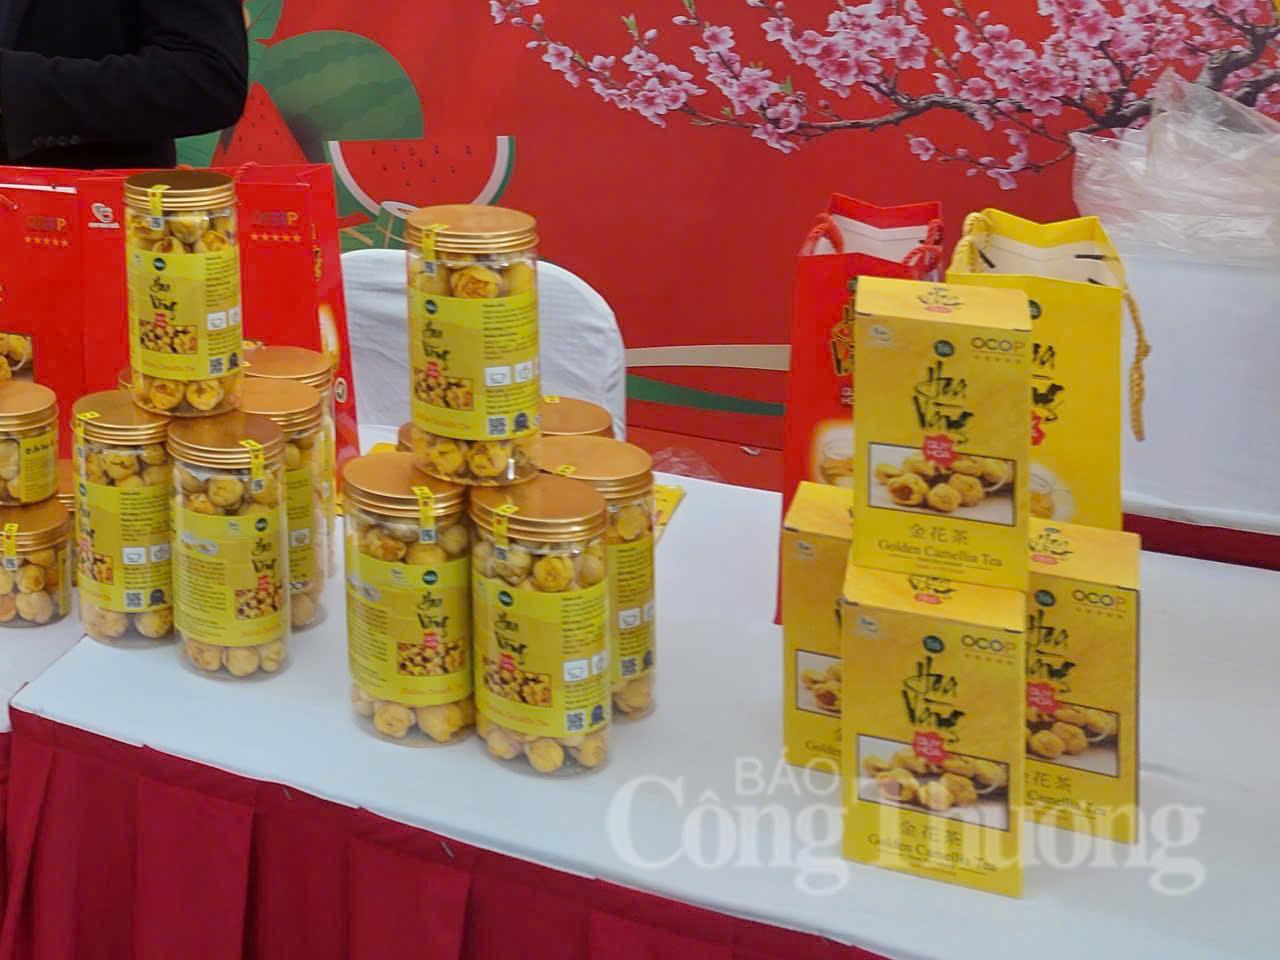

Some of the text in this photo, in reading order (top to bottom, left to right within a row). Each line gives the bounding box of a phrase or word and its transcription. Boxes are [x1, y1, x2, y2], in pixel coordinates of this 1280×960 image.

[971, 336, 1026, 353] OCOP
[1072, 589, 1126, 608] OCOP
[961, 634, 1017, 653] OCOP
